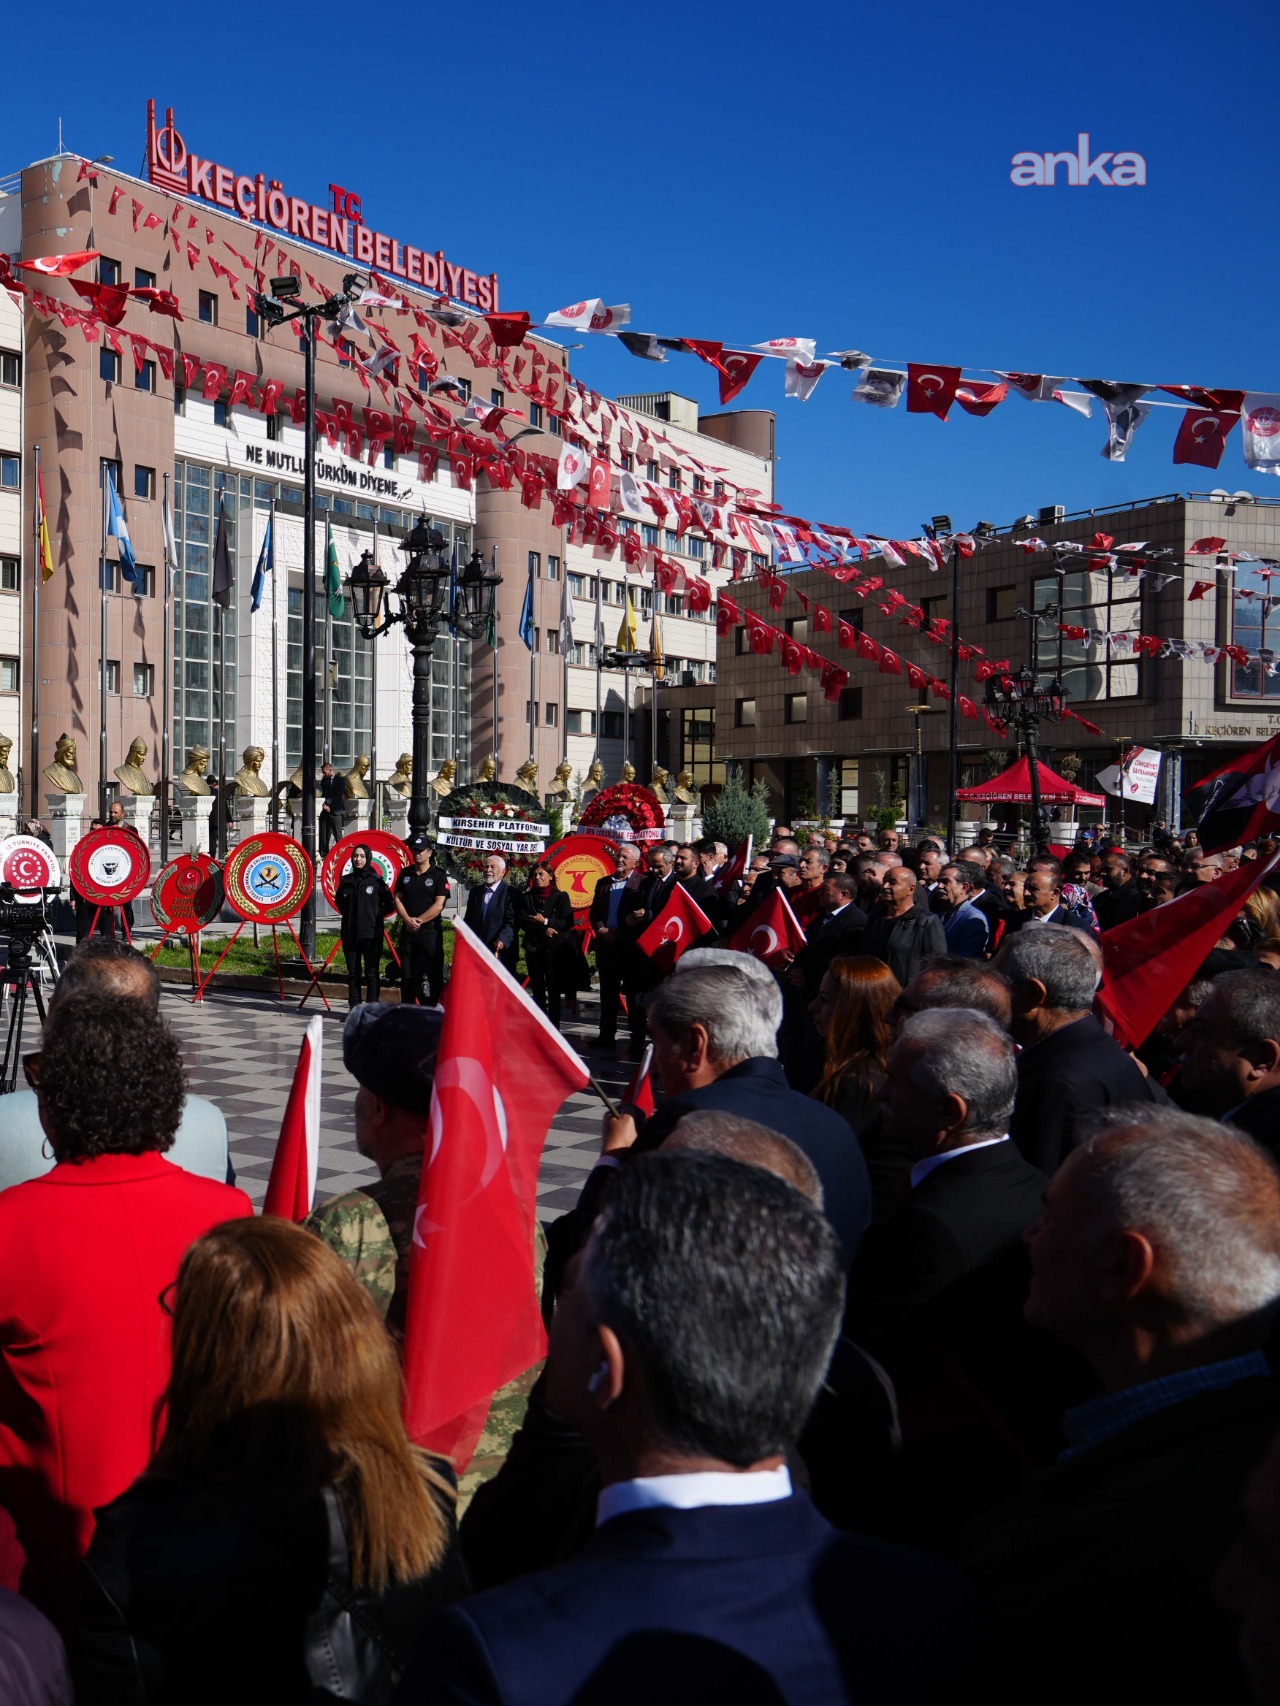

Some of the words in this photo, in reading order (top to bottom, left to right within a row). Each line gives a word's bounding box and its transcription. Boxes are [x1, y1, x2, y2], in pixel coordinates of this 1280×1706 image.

[329, 184, 364, 225] T.C.
[186, 154, 349, 255] KEÇİÖREN
[353, 224, 499, 313] BELEDİYESİ
[246, 444, 263, 464] NE
[266, 450, 305, 473] MUTLU
[360, 471, 398, 496] DİYENE
[1205, 725, 1251, 737] KEÇİÖREN
[1014, 792, 1056, 800] BELEYESİ
[476, 840, 484, 849] VE
[487, 841, 513, 851] SOSYAL
